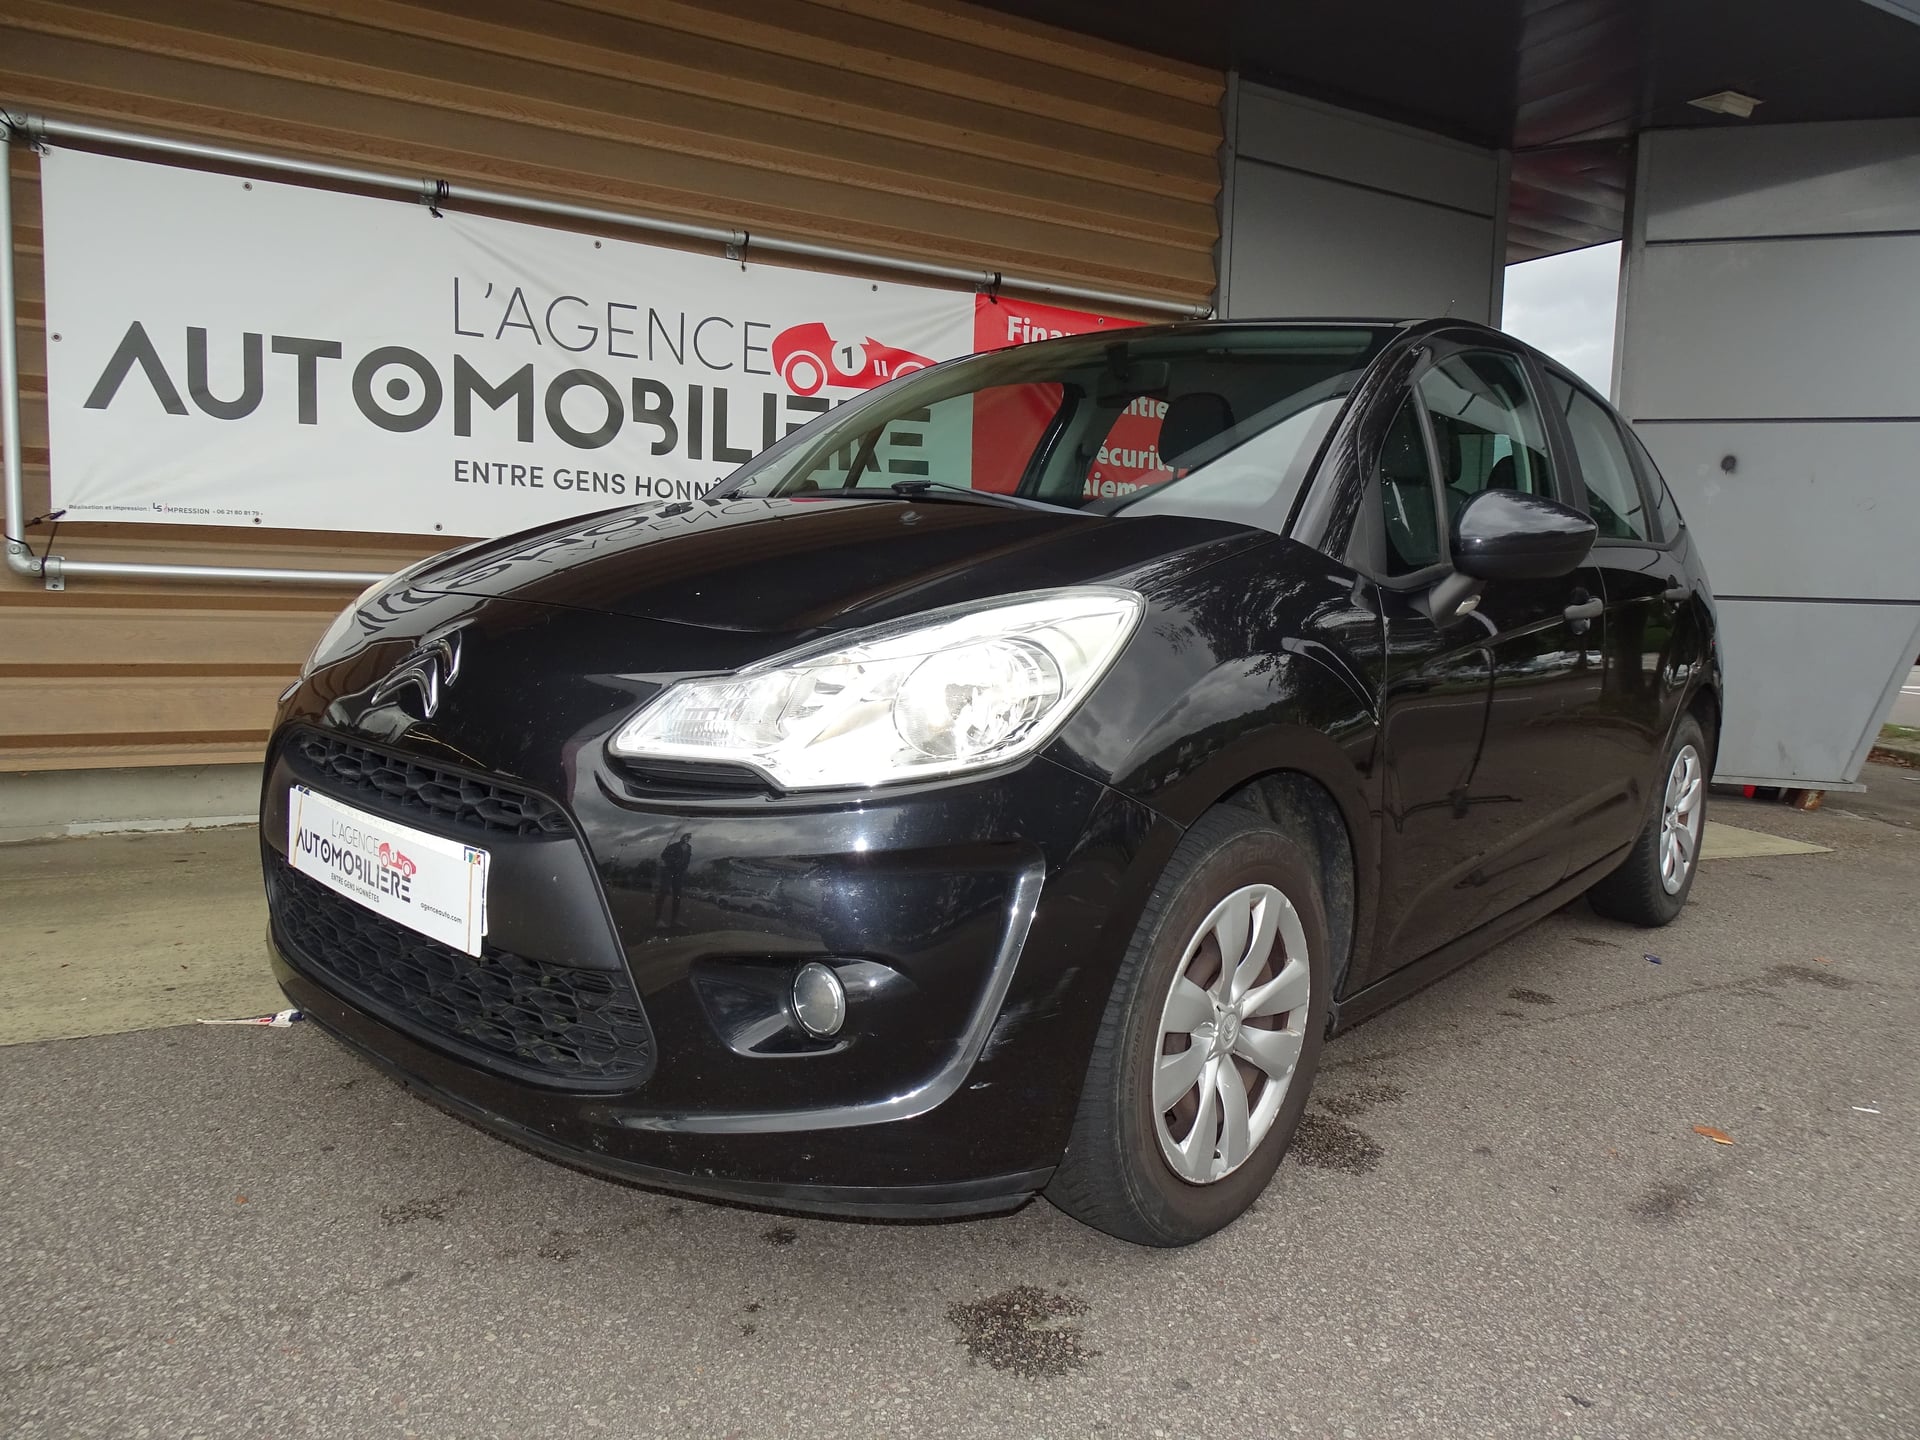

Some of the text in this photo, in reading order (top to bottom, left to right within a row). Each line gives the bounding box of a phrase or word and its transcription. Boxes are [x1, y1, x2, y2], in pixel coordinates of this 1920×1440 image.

[454, 277, 771, 375] L'AGENCE
[842, 346, 853, 369] 1
[454, 460, 722, 500] ENTRE GENS HONN
[332, 819, 380, 857] L'AGENCE
[331, 872, 344, 886] ENTRE
[344, 880, 355, 891] GENS
[420, 902, 463, 924] agenceauto.com
